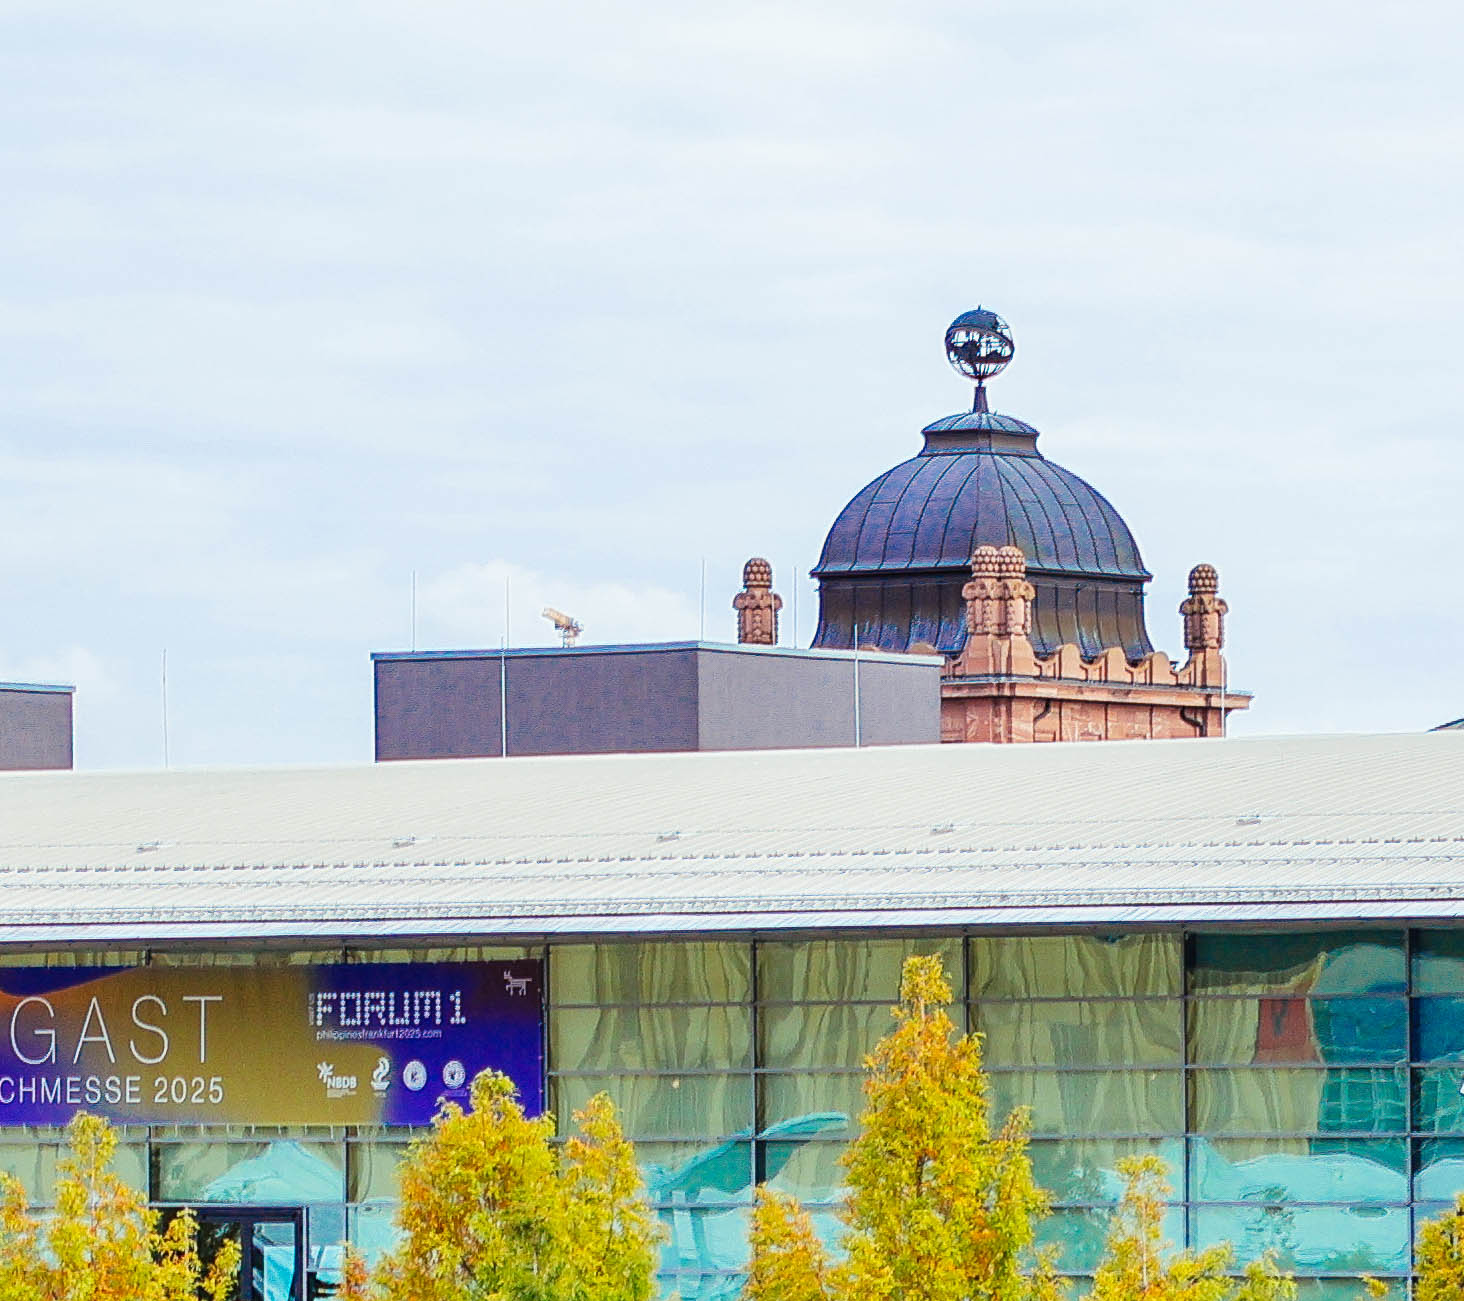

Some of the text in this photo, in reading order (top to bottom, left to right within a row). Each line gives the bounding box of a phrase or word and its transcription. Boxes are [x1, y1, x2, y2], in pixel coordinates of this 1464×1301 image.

[316, 991, 441, 1027] FORUM
[450, 991, 467, 1025] 1
[153, 1075, 224, 1105] 2025
